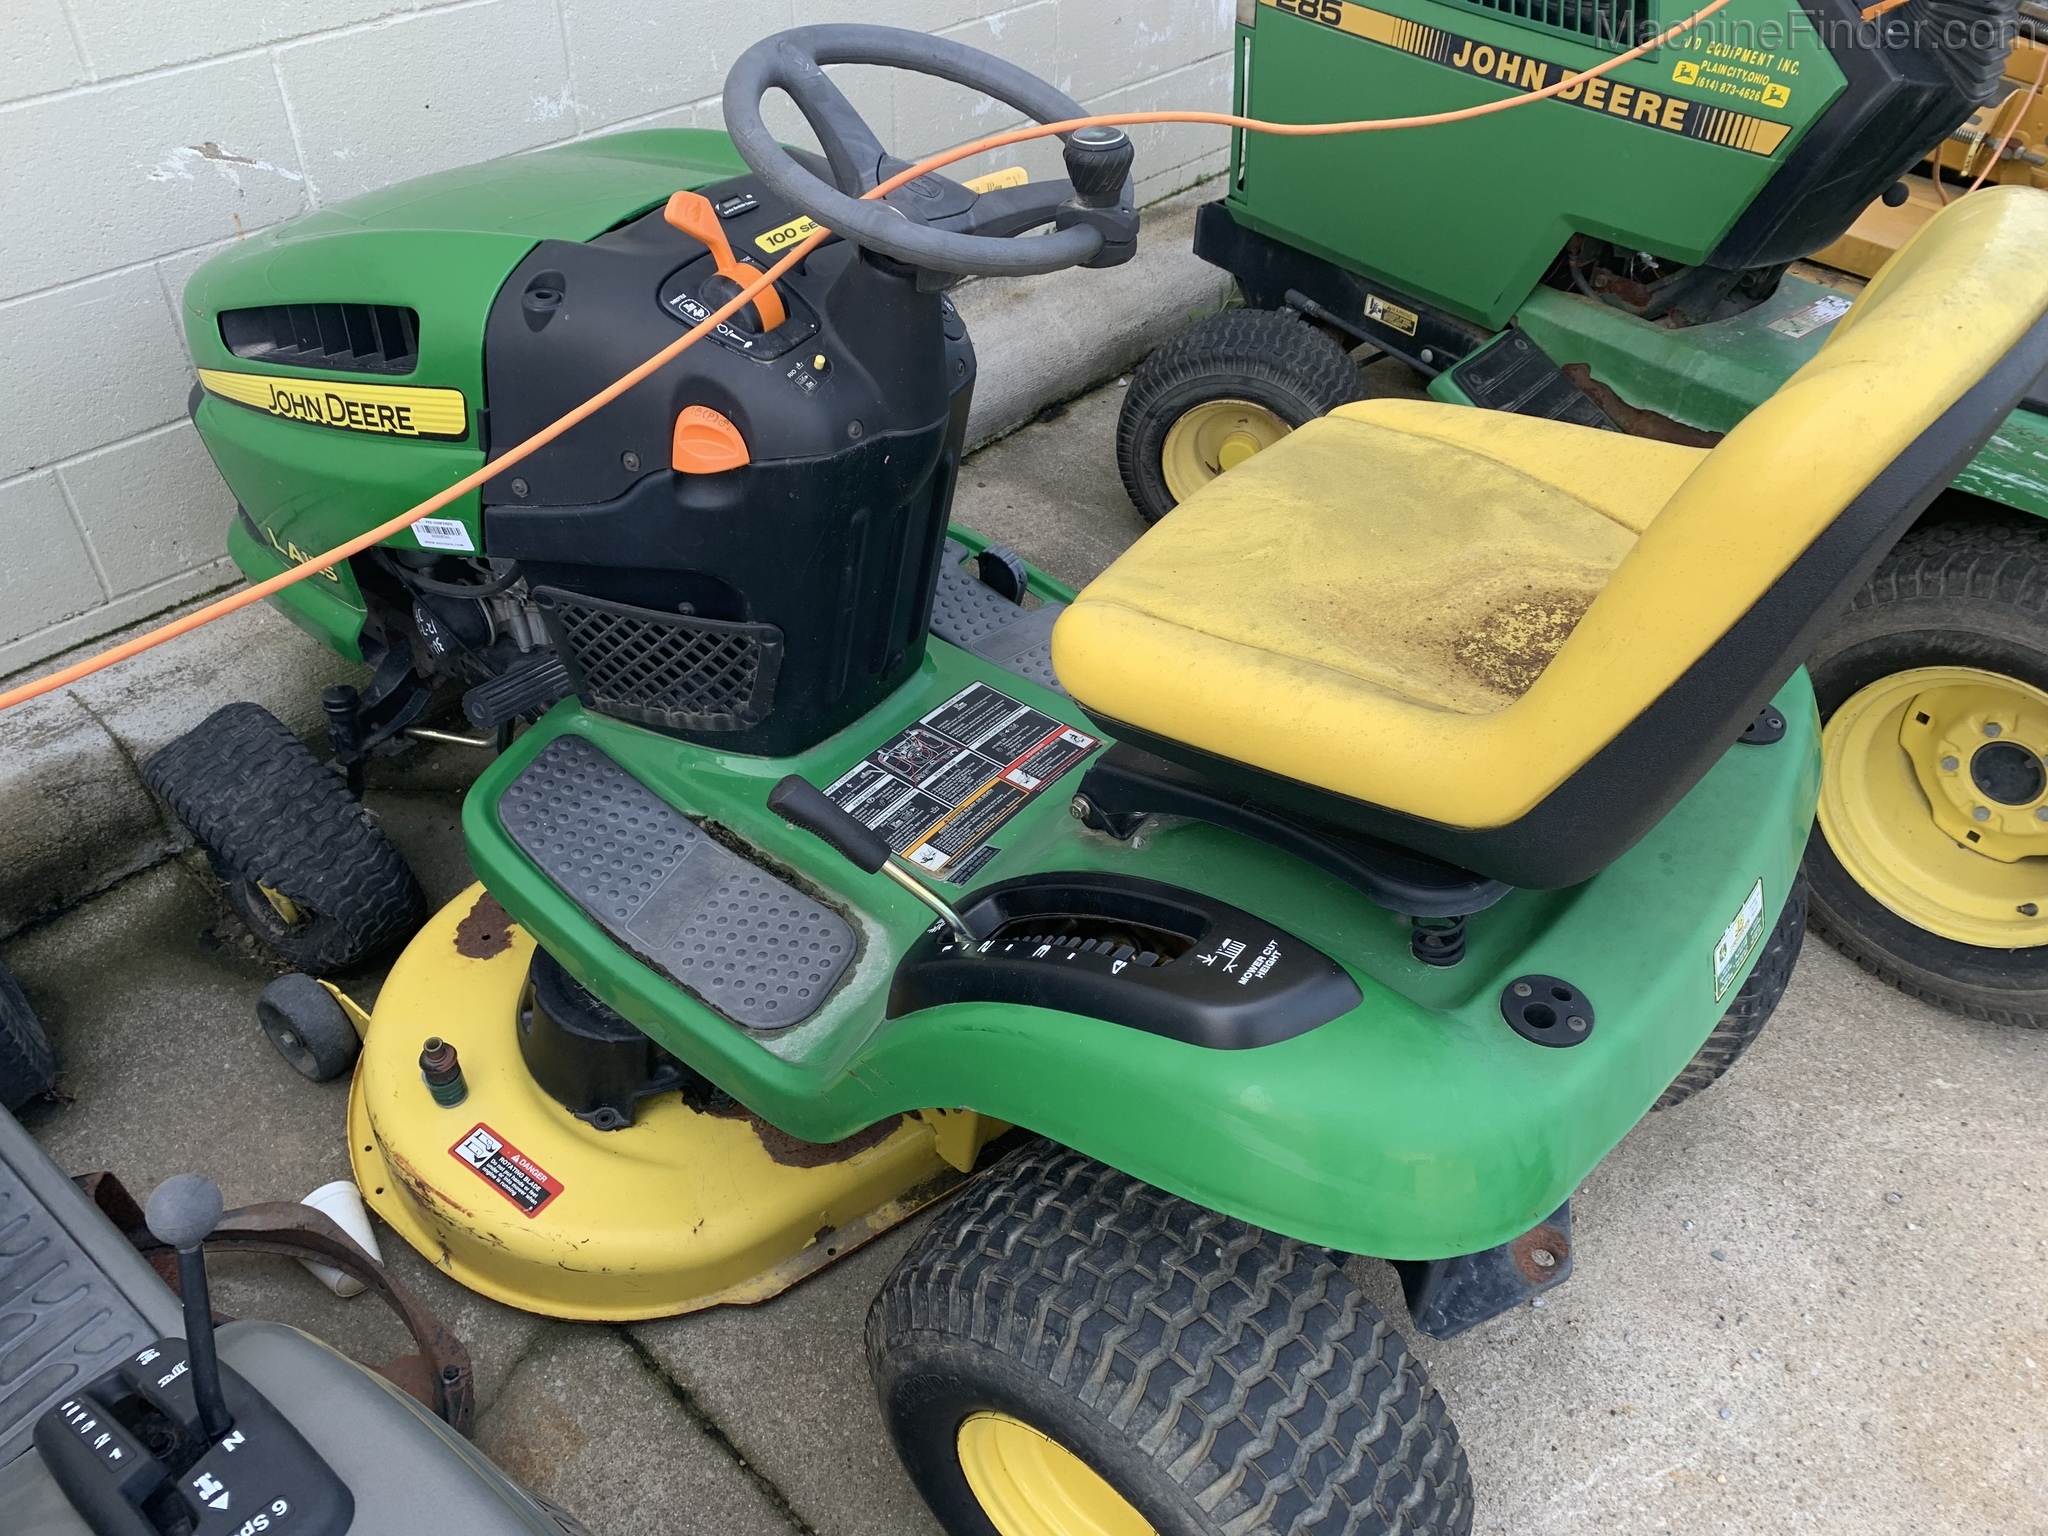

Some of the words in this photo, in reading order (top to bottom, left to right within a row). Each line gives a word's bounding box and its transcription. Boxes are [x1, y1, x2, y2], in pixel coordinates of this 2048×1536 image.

[1706, 40, 1775, 68] EQUIPMENT
[1777, 57, 1800, 76] INC.
[1452, 40, 1548, 91] JOHN
[1557, 69, 1689, 131] DEERE
[1696, 76, 1718, 91] (614)
[1720, 84, 1762, 101] 873-4626
[765, 227, 797, 247] 100
[800, 221, 818, 234] SE
[268, 383, 324, 420] JOHN
[325, 392, 415, 431] DEERE
[1032, 944, 1052, 958] 3
[1112, 960, 1128, 975] 4
[1238, 955, 1267, 985] MOWER
[1262, 939, 1279, 956] CUT
[1255, 950, 1281, 979] HEIGHT
[499, 1156, 525, 1178] ROTATING
[523, 1176, 542, 1192] BLADE
[518, 1159, 548, 1183] DANGER
[94, 1433, 112, 1450] 2
[108, 1447, 122, 1460] 1
[222, 1430, 246, 1453] N
[271, 1500, 288, 1516] 6
[234, 1514, 270, 1536] Sp
